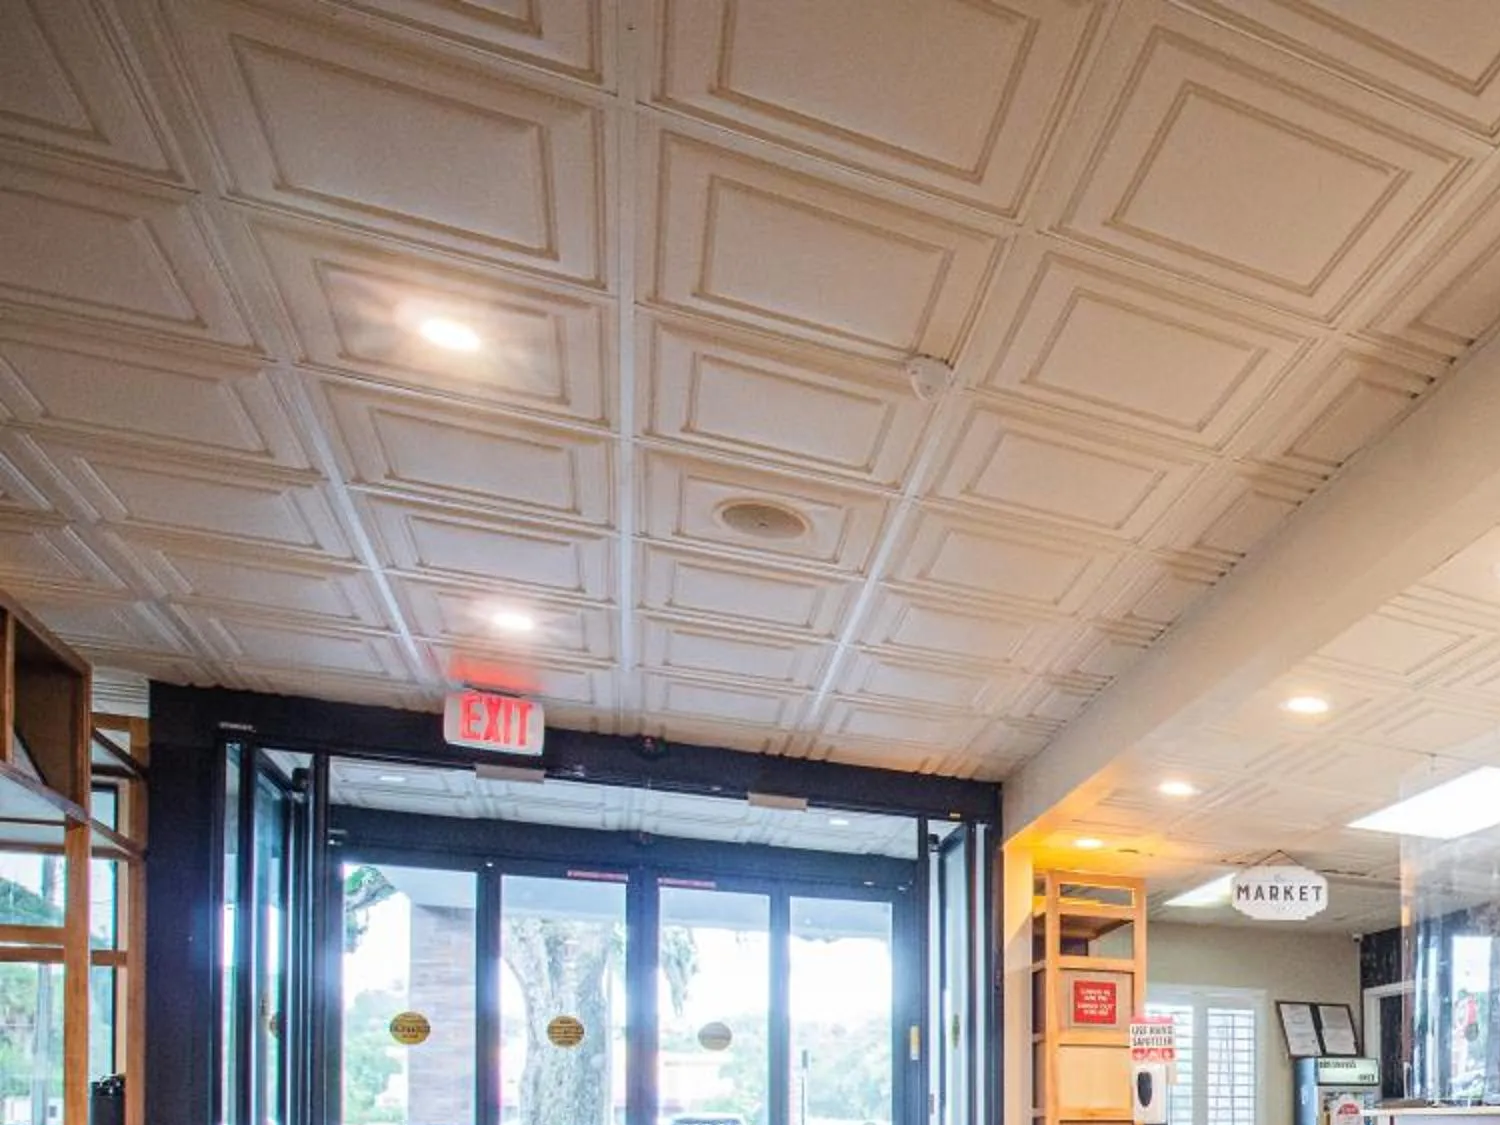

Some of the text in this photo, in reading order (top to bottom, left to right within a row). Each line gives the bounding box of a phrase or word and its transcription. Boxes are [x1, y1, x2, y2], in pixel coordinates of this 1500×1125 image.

[459, 694, 533, 747] EXIT
[1236, 884, 1323, 902] MARKET
[1131, 1025, 1173, 1035] USE HAND
